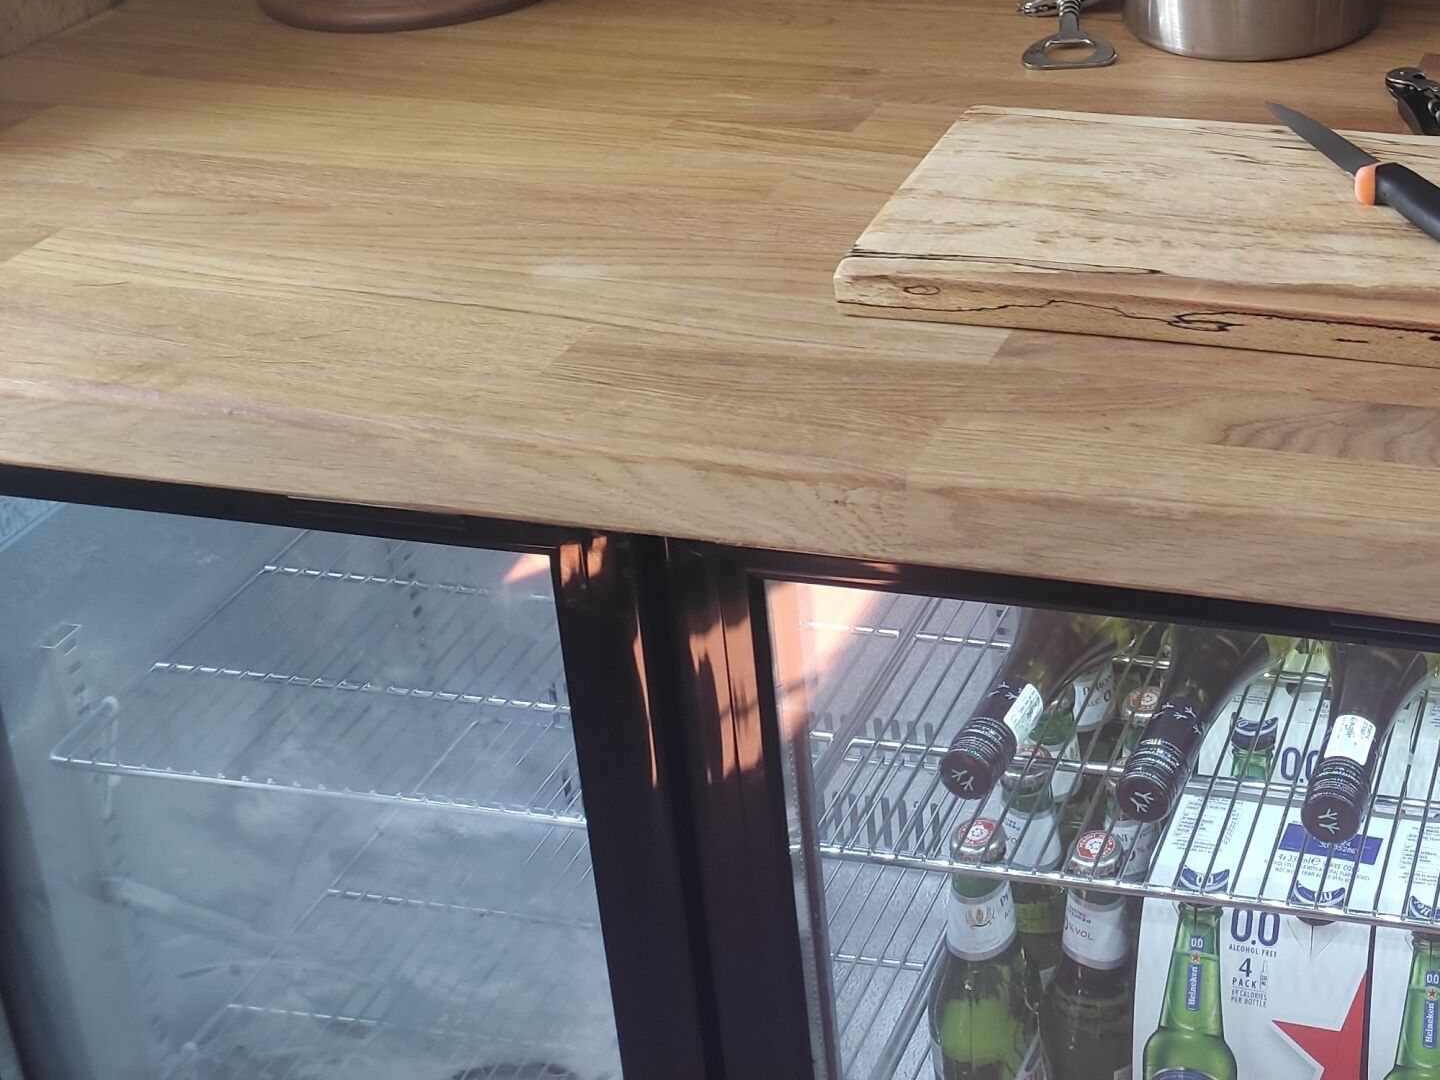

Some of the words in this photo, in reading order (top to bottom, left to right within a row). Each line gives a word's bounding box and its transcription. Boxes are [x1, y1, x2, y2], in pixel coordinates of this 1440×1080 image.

[1230, 908, 1281, 947] 0.0
[1191, 938, 1204, 948] 0.0
[1228, 944, 1259, 956] ALCOHOL
[1262, 948, 1278, 958] FREE
[1238, 958, 1252, 978] 4
[1232, 976, 1258, 989] PACK
[1426, 973, 1440, 984] 0.0
[1186, 966, 1198, 1006] Heineken
[1238, 990, 1268, 1001] CALORIES
[1244, 998, 1267, 1008] BOTTLE
[1424, 1001, 1435, 1044] Heineken
